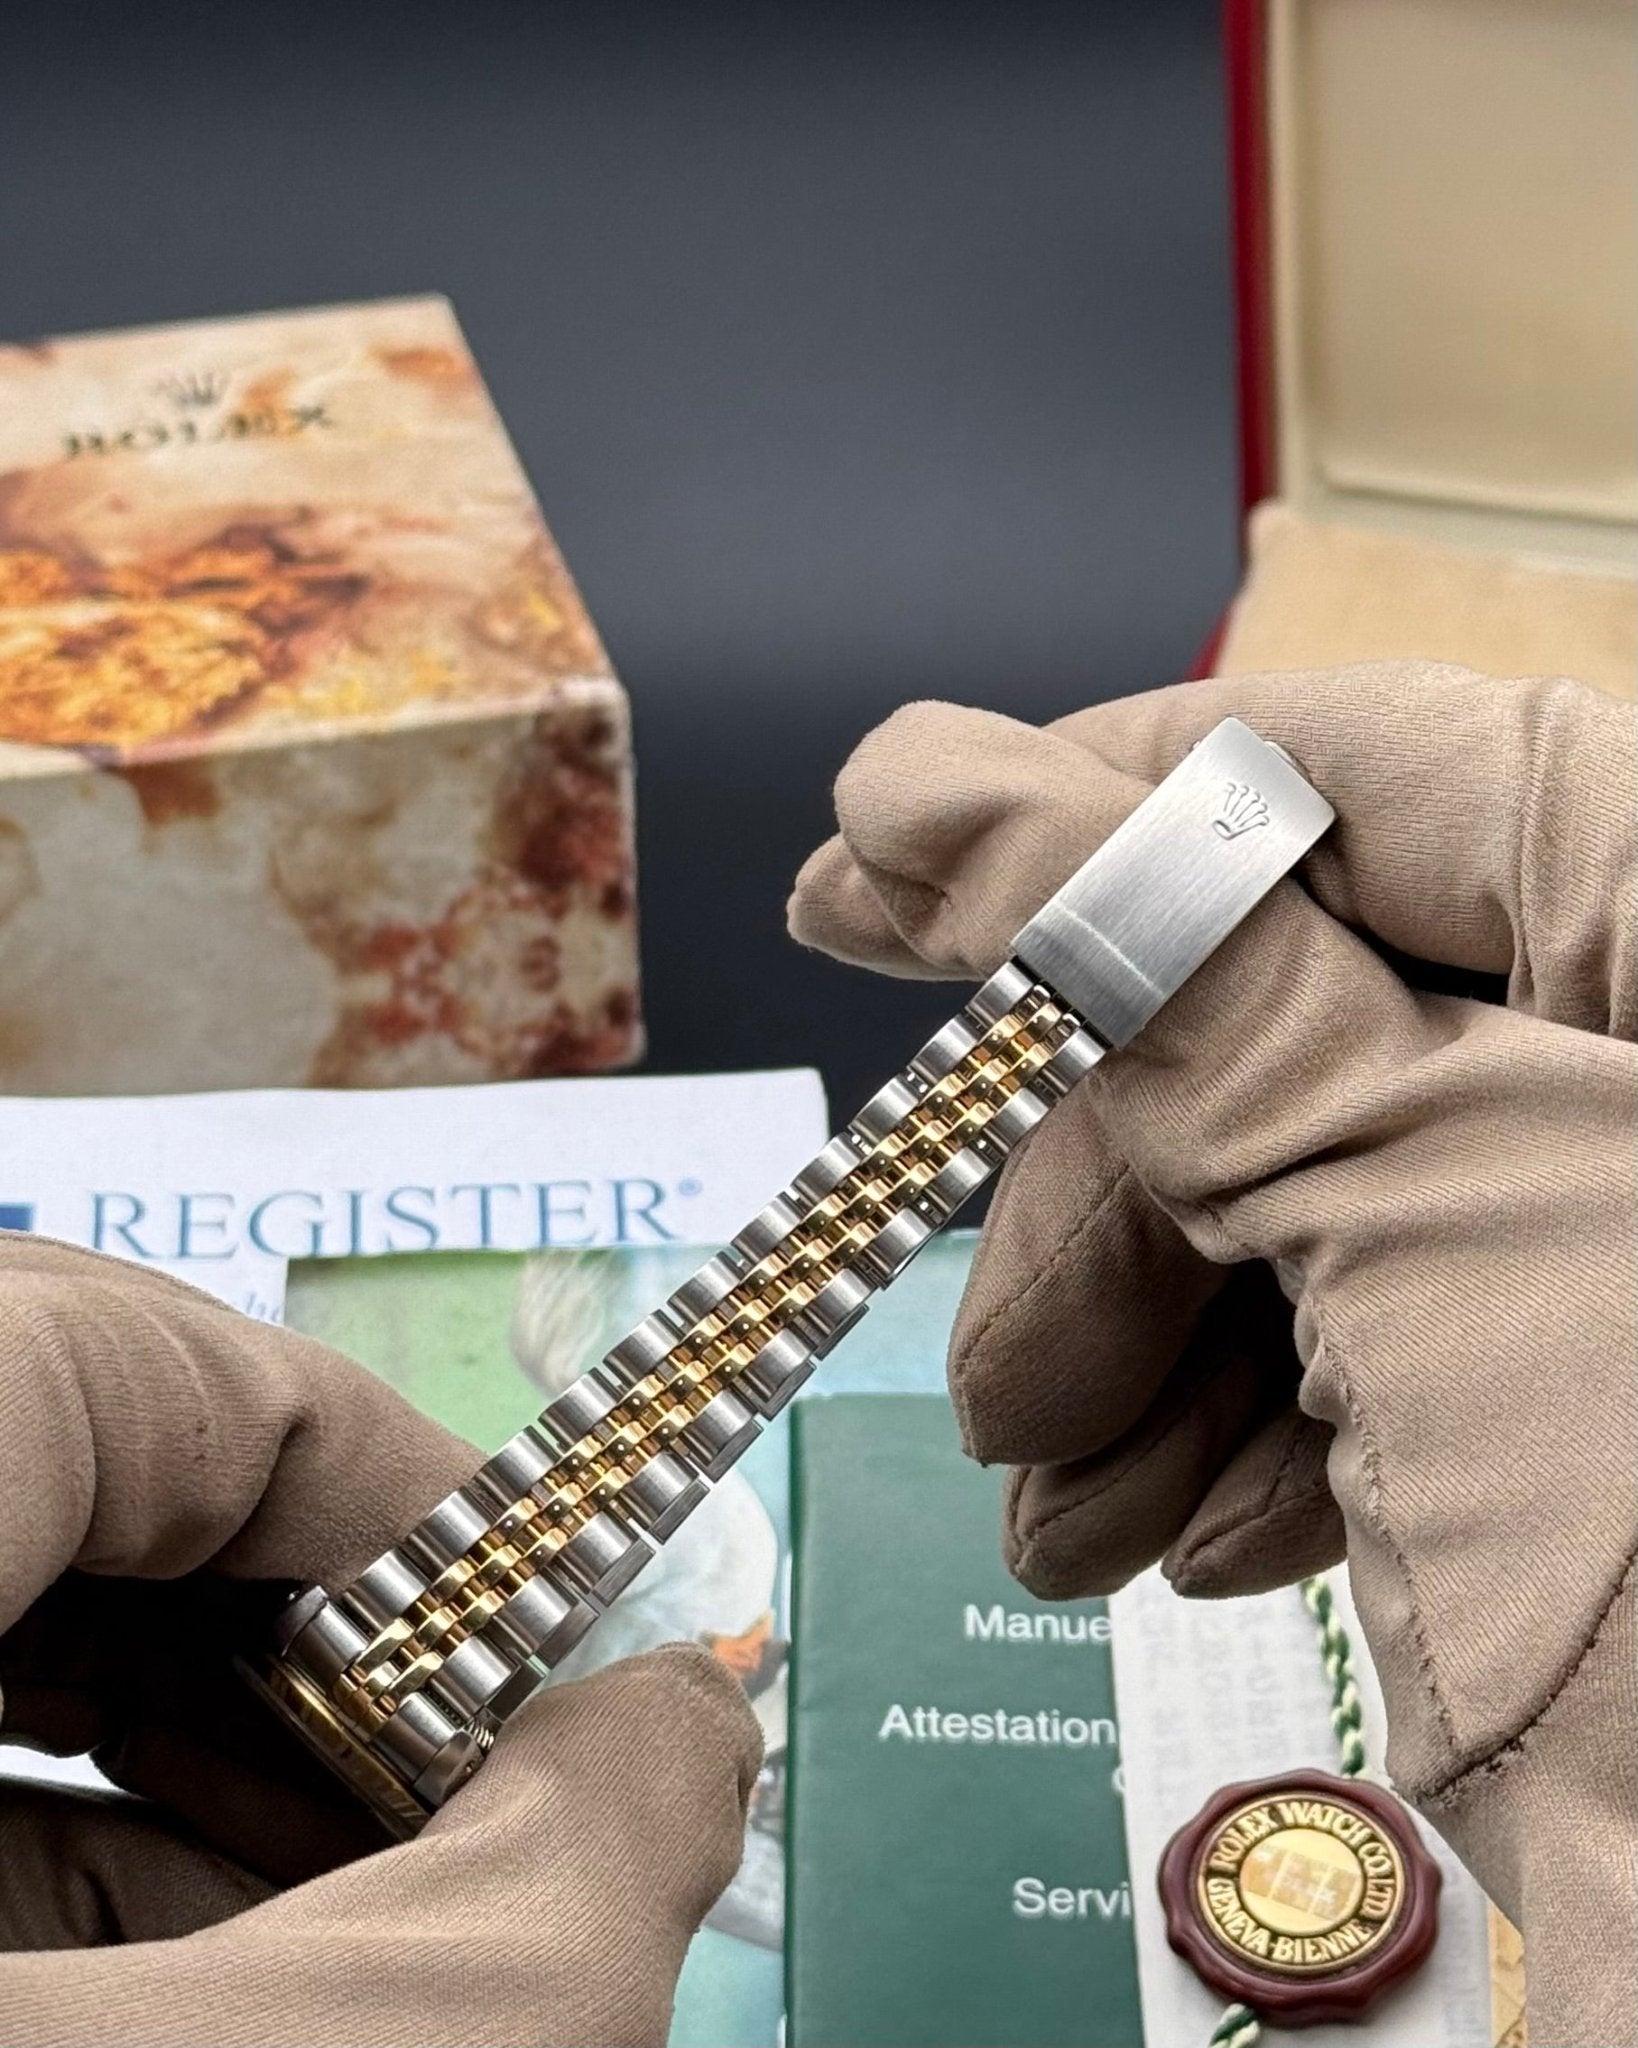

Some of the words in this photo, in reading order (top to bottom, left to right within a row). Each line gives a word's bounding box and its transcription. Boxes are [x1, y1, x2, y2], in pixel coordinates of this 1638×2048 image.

[63, 402, 336, 458] ROLEX
[879, 1704, 1117, 1746] Attestation
[1210, 1806, 1278, 1870] ROLEX
[1278, 1801, 1371, 1847] WATCH
